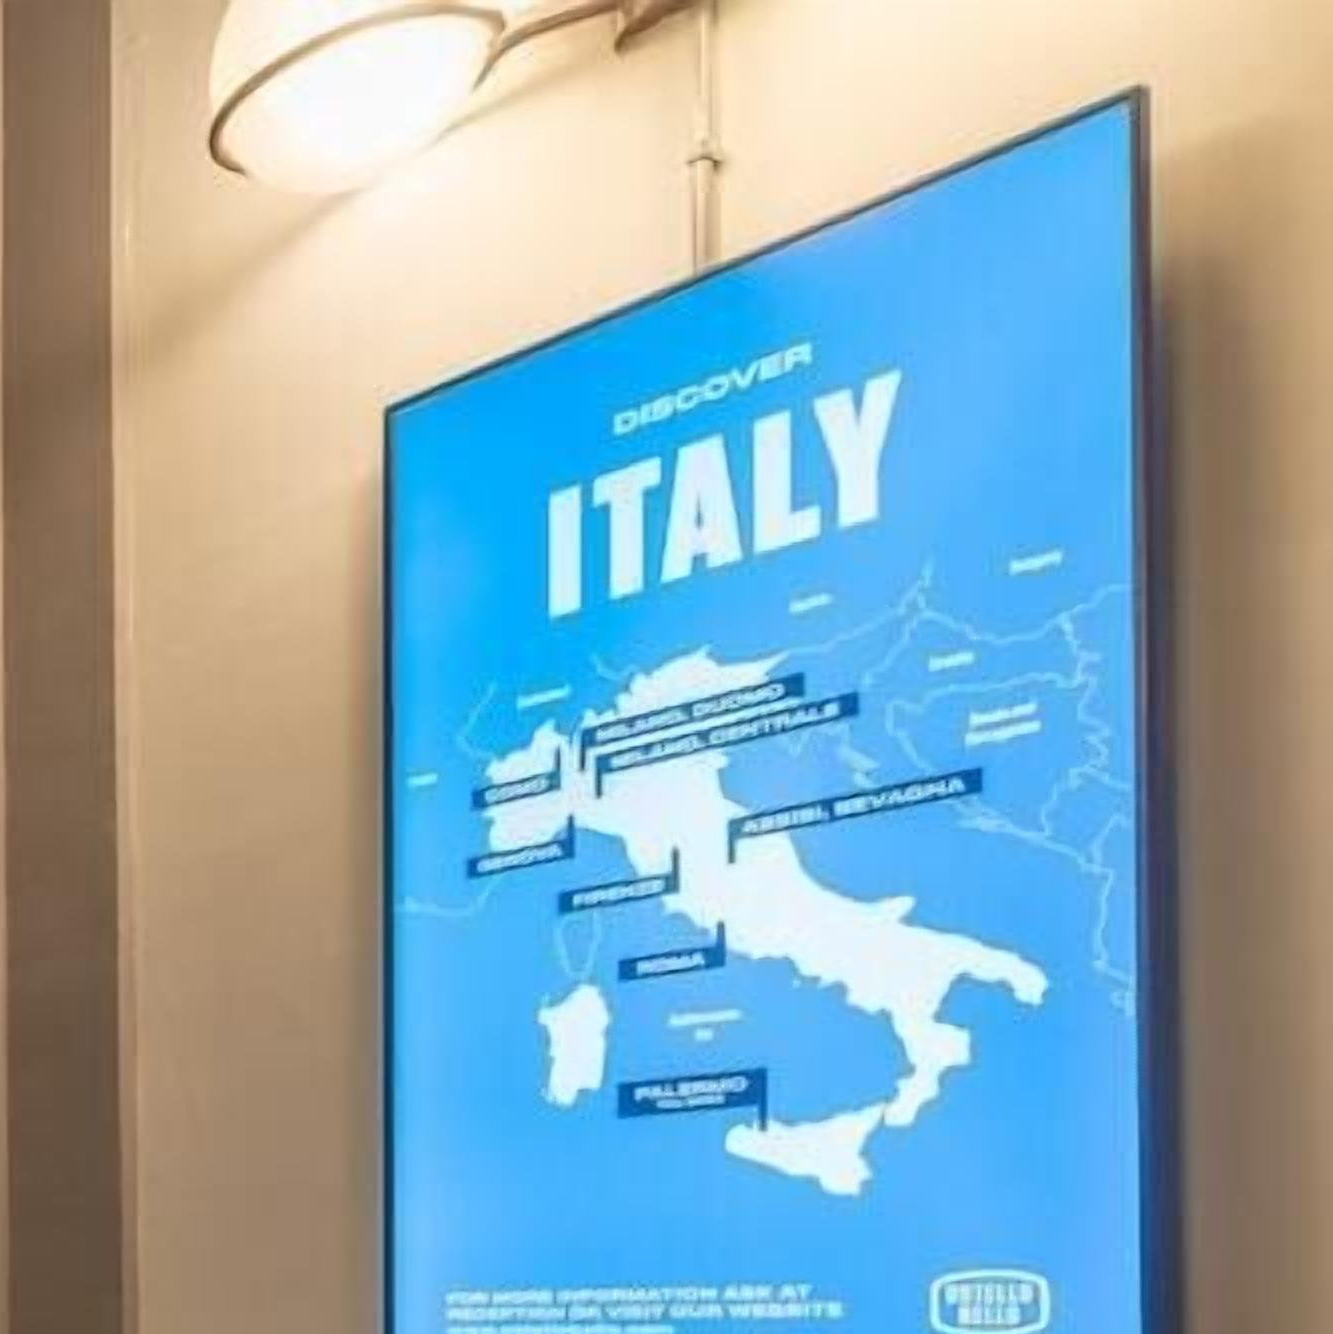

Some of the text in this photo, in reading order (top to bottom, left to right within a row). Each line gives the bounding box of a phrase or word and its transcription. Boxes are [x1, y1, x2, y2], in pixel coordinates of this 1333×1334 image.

[612, 343, 813, 435] DISCOVER
[548, 368, 902, 619] ITALY
[636, 951, 706, 977] ROMA
[634, 1075, 750, 1101] PALERMO
[556, 1285, 718, 1305] INFORMATION
[779, 1283, 813, 1300] AT
[603, 1303, 665, 1321] VISIT
